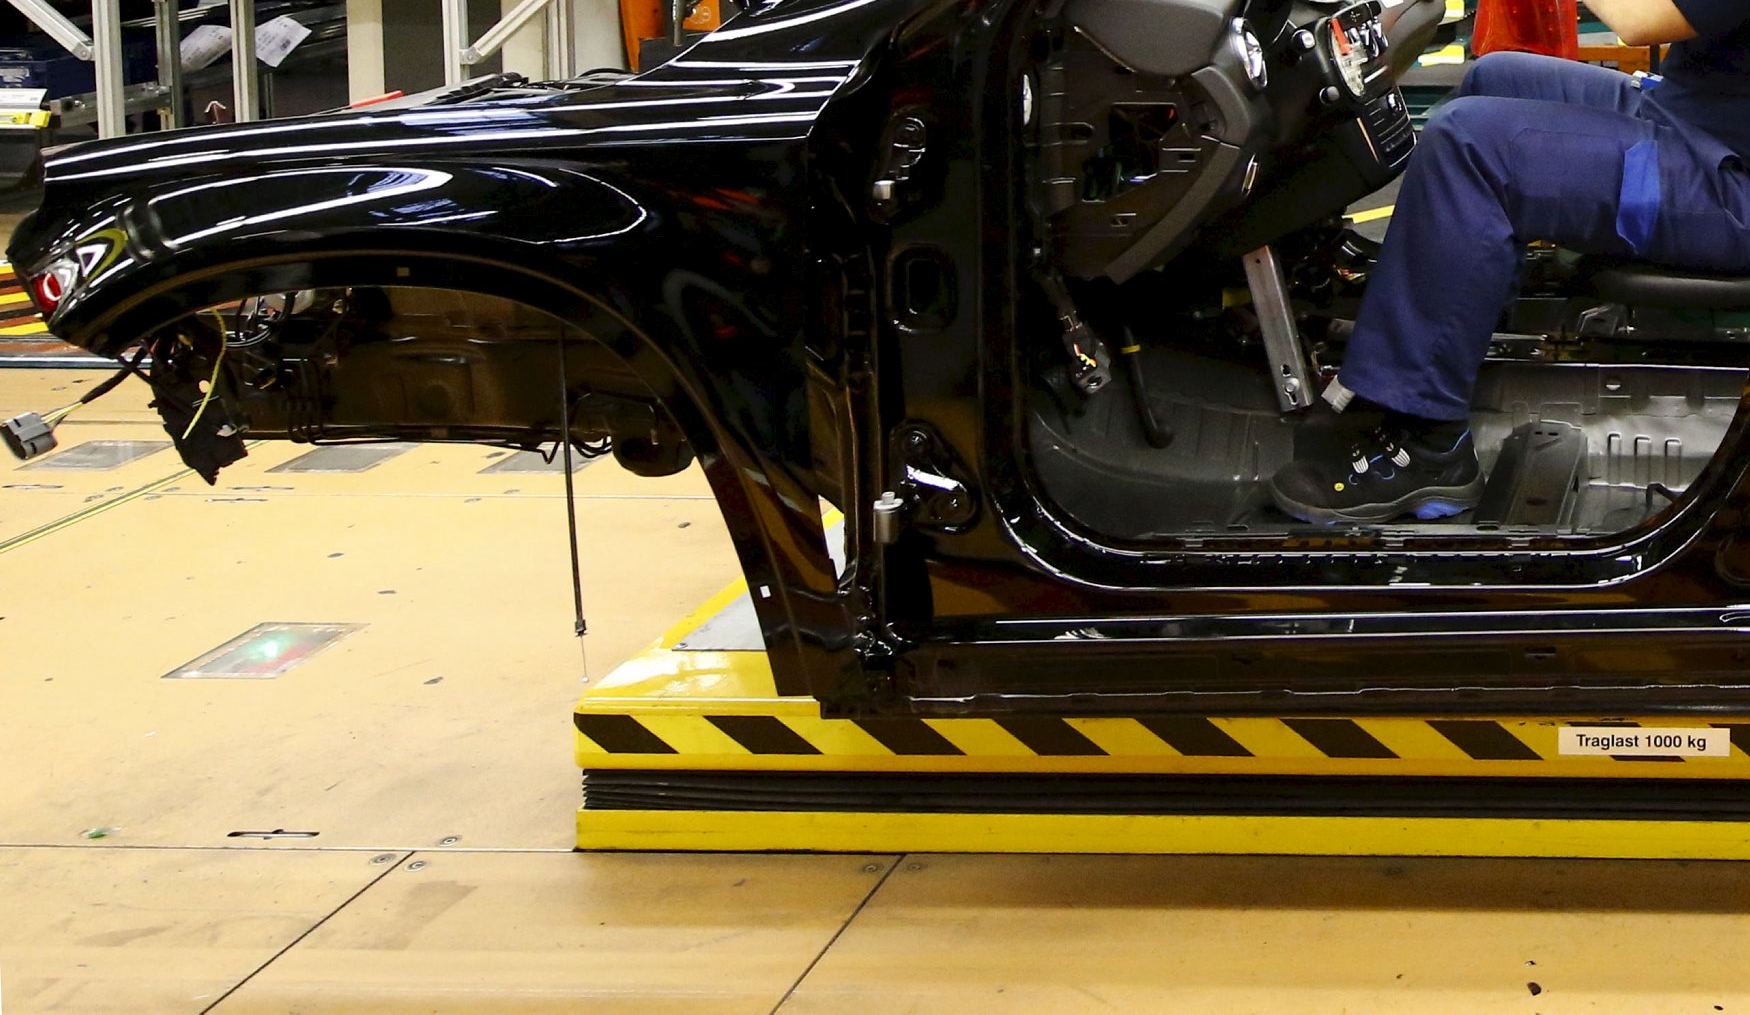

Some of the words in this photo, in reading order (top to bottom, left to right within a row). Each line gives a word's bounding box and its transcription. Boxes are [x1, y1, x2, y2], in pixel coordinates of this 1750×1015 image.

[1576, 733, 1639, 751] Traglast
[1645, 734, 1682, 748] 1000
[1687, 734, 1707, 752] kg
